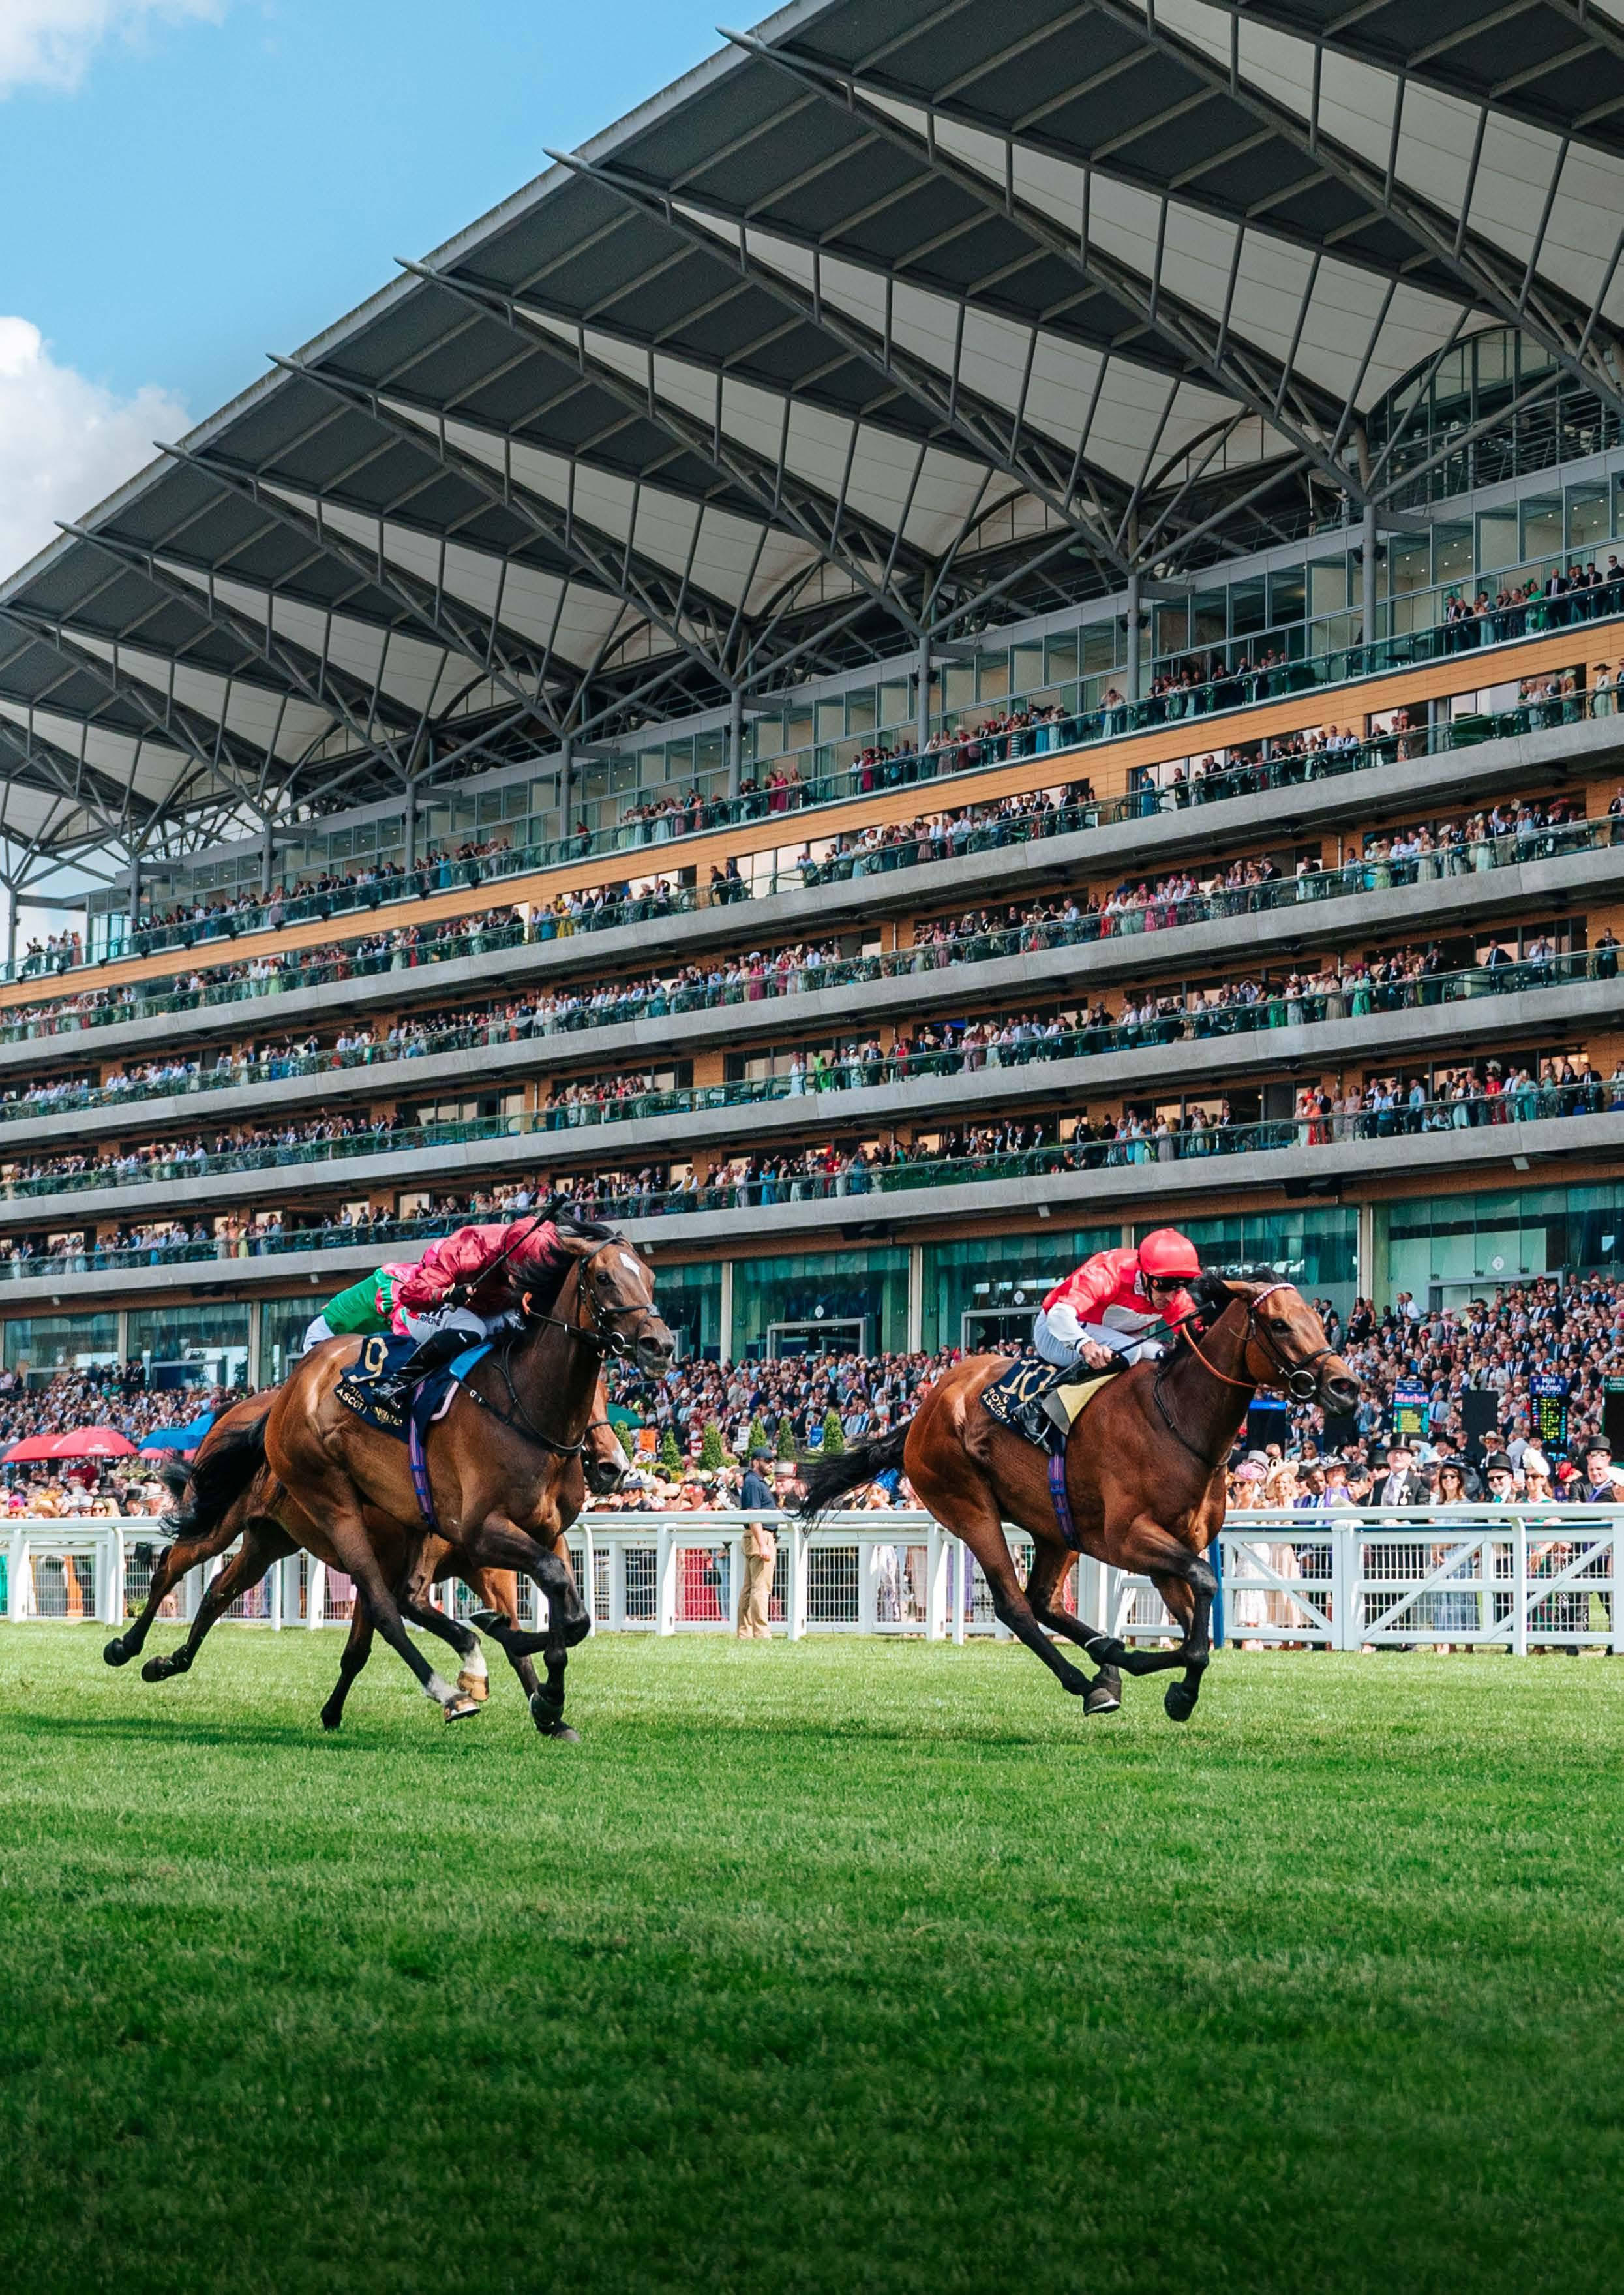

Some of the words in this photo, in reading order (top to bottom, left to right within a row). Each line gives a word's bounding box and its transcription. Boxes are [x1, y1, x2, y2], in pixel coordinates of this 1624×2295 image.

[348, 1337, 389, 1383] 9
[999, 1359, 1057, 1402] 10
[336, 1388, 364, 1410] ASCOT
[982, 1393, 1008, 1420] ASCOT
